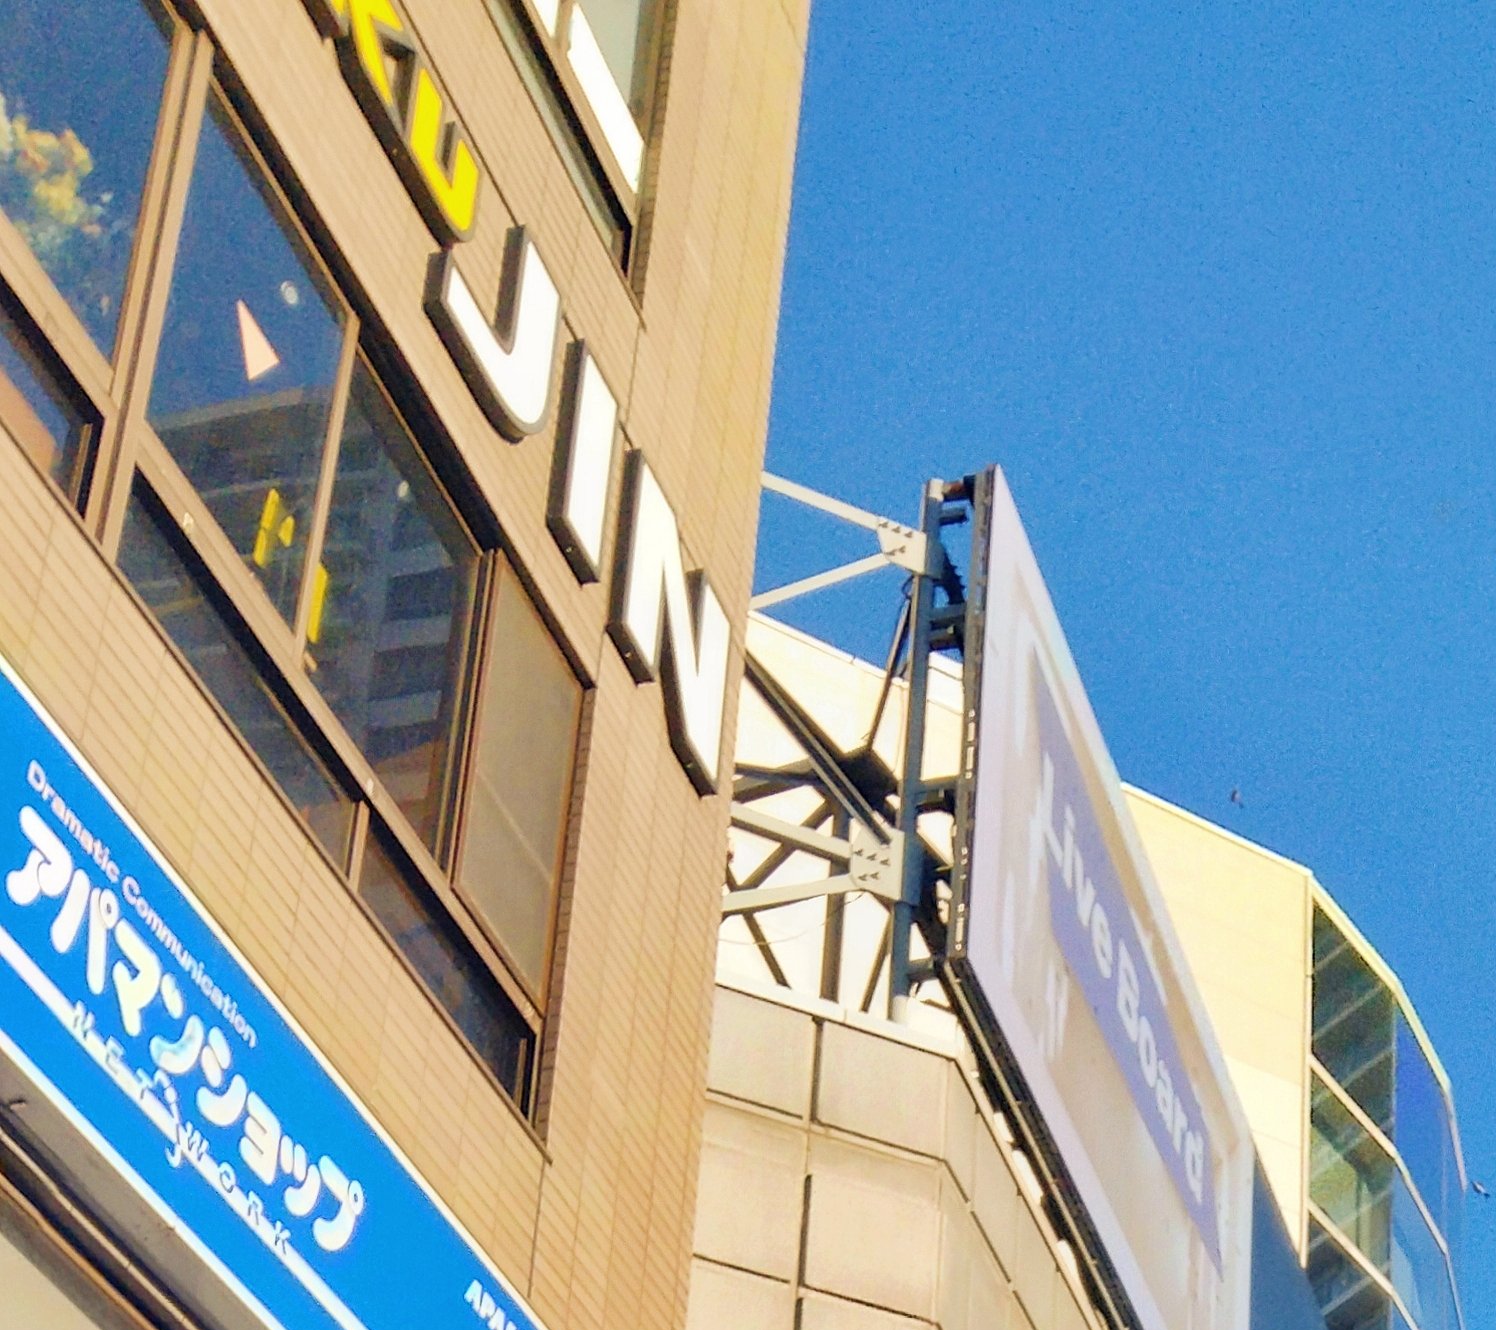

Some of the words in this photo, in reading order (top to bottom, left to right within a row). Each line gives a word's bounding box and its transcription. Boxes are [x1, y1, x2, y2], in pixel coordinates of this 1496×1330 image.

[6, 806, 364, 1251] アパマンショップ
[27, 760, 119, 884] Dramatic
[122, 875, 257, 1049] Communication
[1041, 751, 1113, 980] Live
[1117, 938, 1206, 1204] Board
